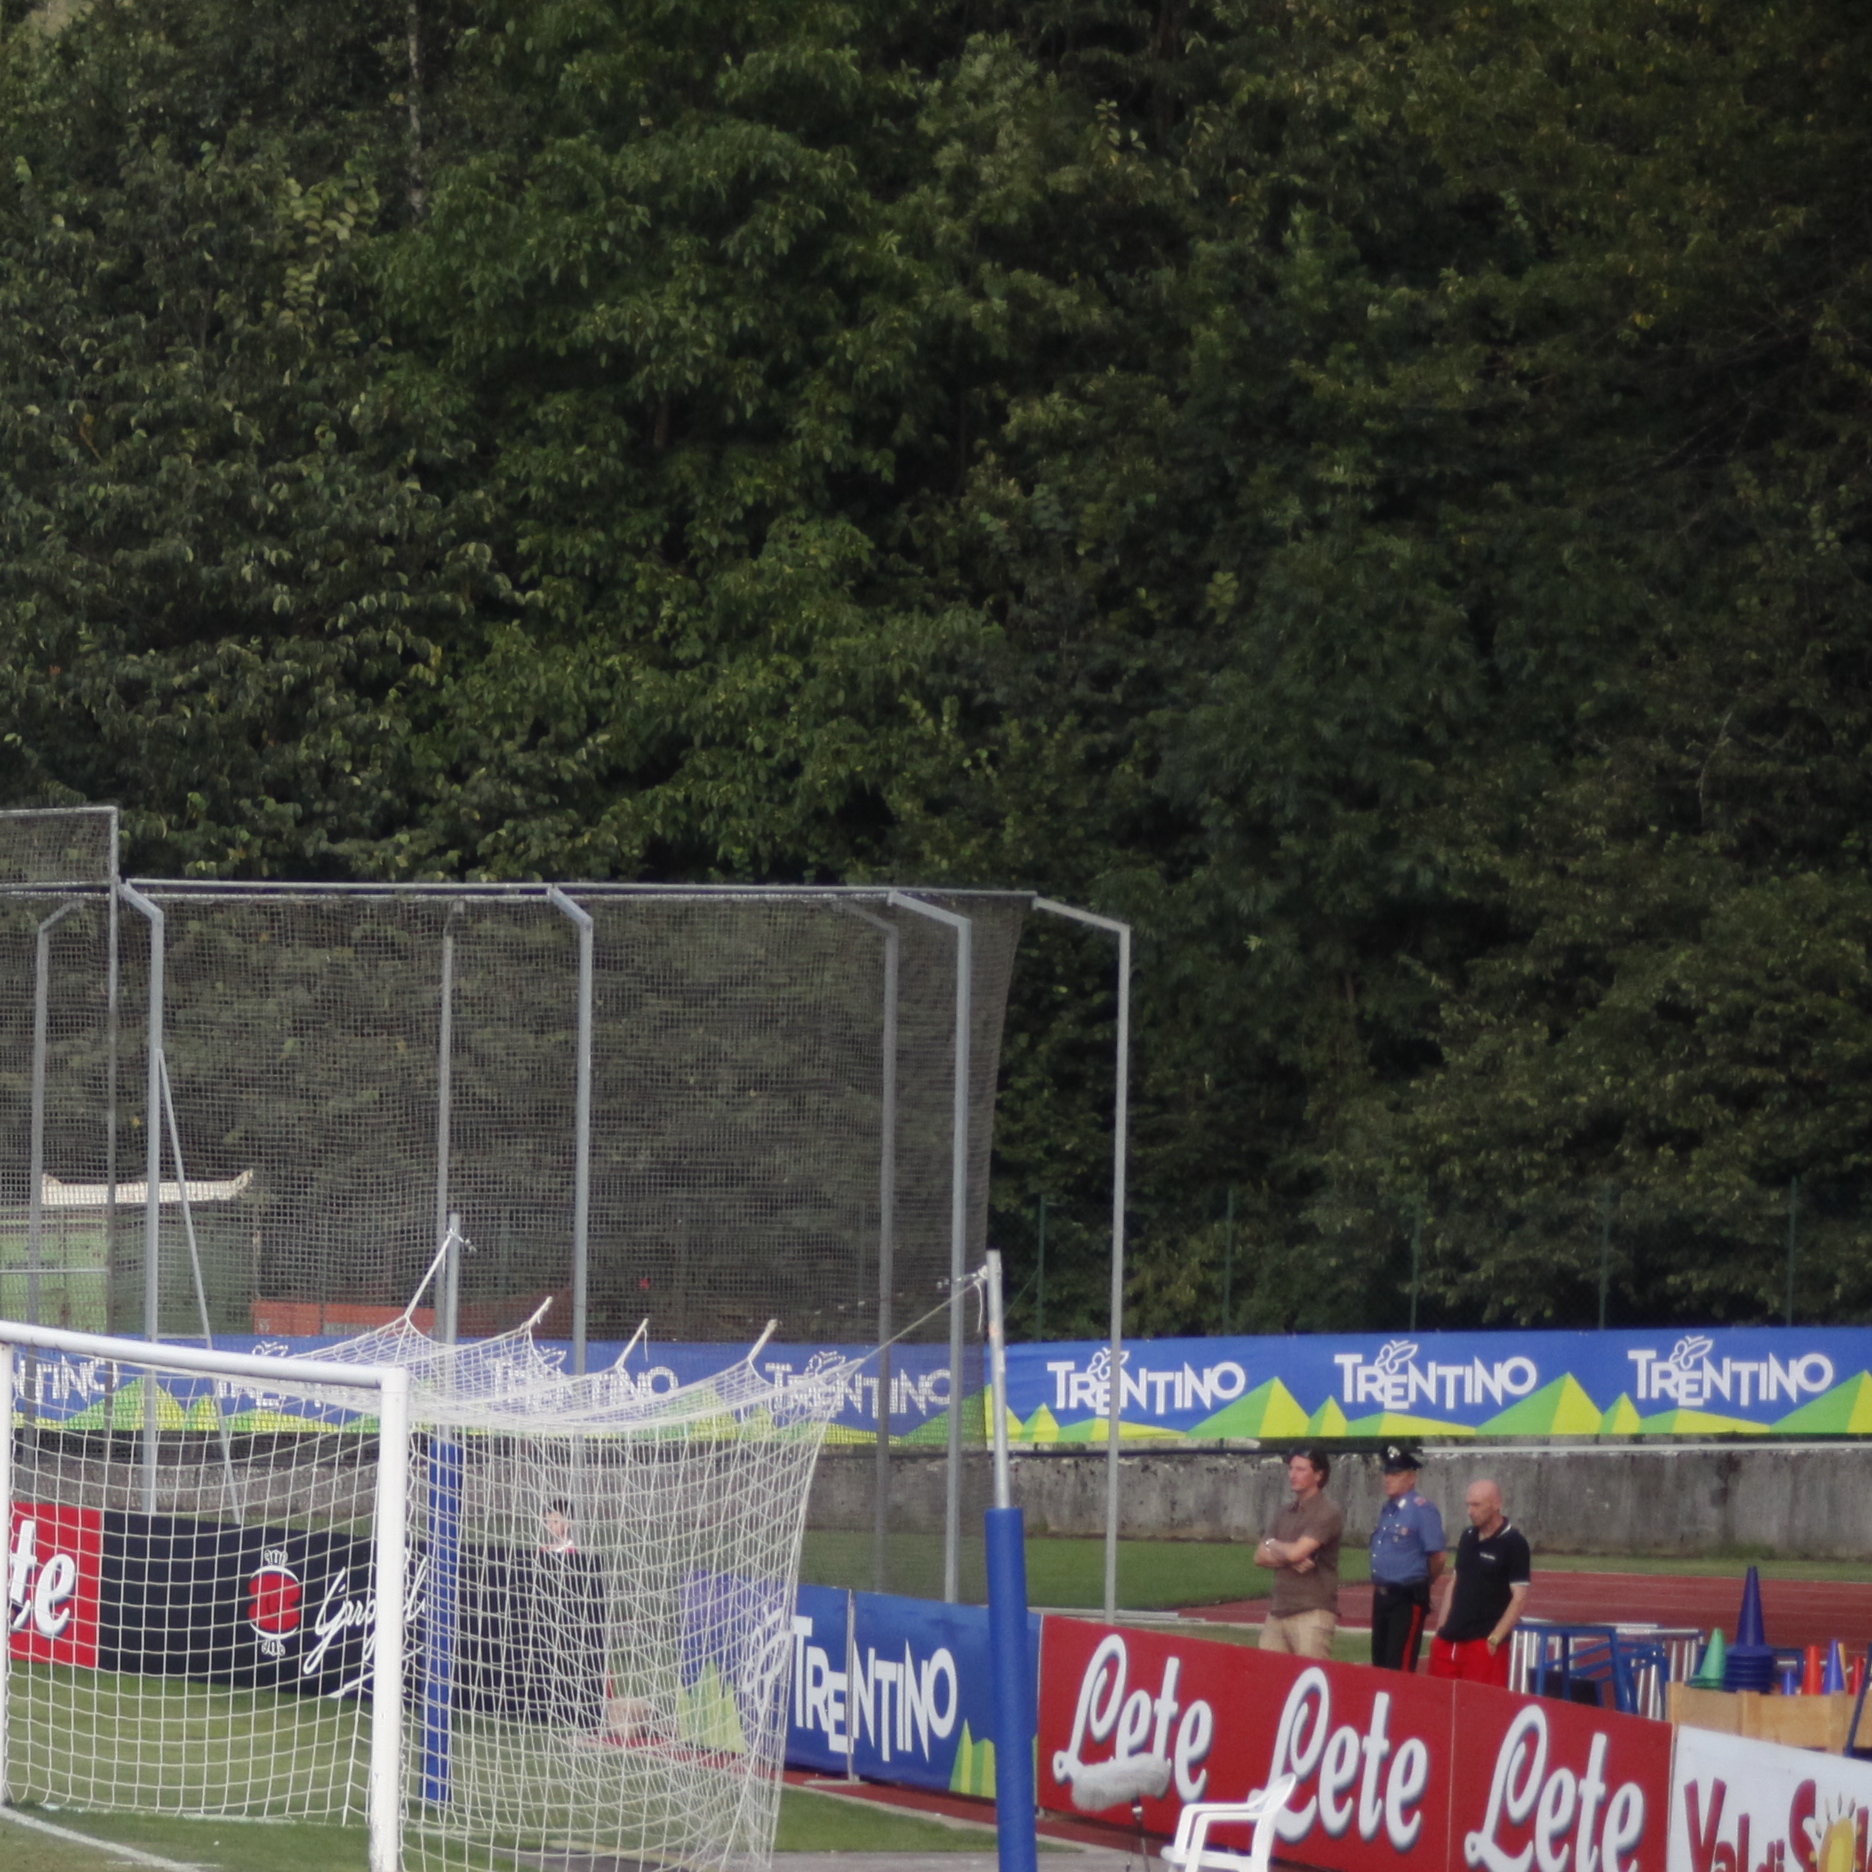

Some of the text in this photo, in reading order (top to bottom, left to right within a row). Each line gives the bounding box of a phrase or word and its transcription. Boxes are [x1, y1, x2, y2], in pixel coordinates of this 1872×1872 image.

[1047, 1361, 1246, 1415] TRENTINO
[1334, 1354, 1537, 1410] TRENTINO
[1627, 1350, 1834, 1407] TRENTINO
[791, 1614, 958, 1763] TRENTINO
[1052, 1633, 1214, 1804] Lete
[1247, 1666, 1429, 1852] Lete
